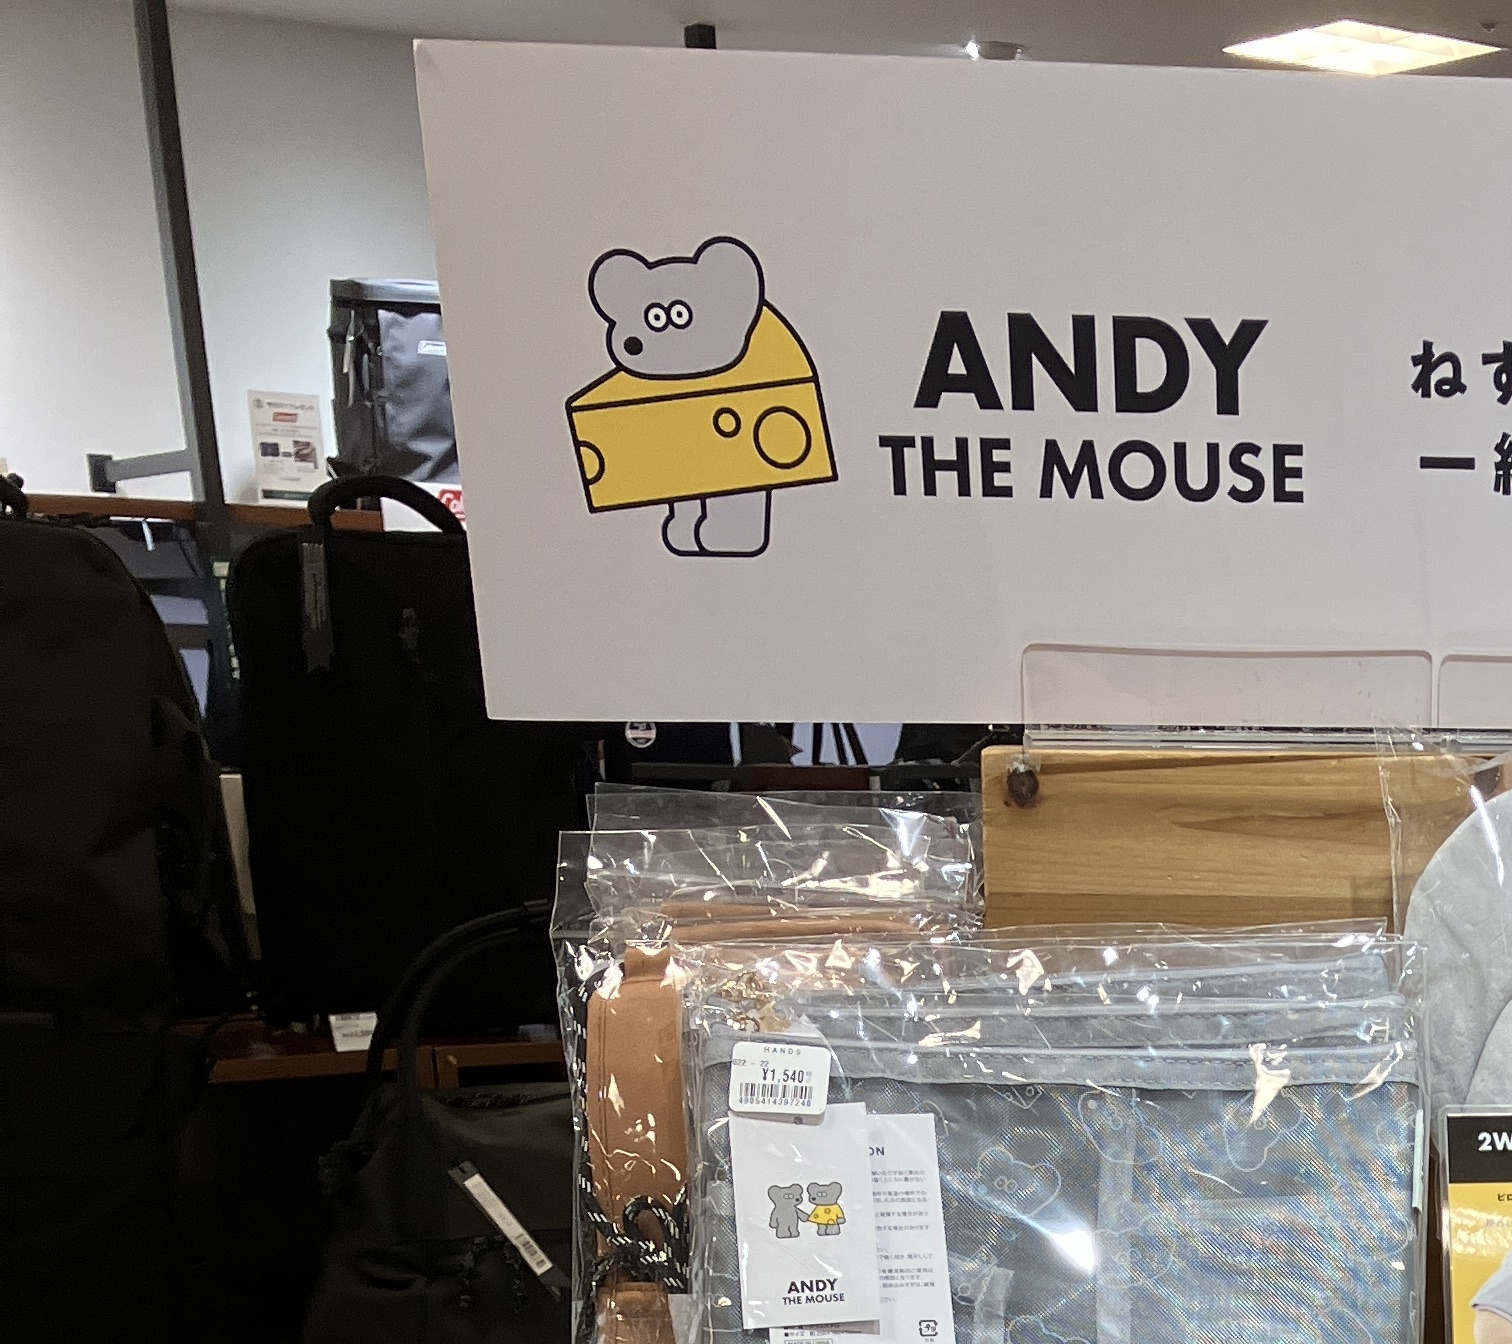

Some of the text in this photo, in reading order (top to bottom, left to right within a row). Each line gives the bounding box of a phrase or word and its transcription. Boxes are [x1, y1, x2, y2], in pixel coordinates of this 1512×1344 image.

[912, 310, 1269, 416] ANDY
[878, 434, 1305, 503] THE MOUSE
[764, 1047, 801, 1055] HANDS
[763, 1068, 804, 1083] ¥1,540
[787, 1279, 838, 1294] ANDY
[782, 1293, 845, 1305] THE MOUSE
